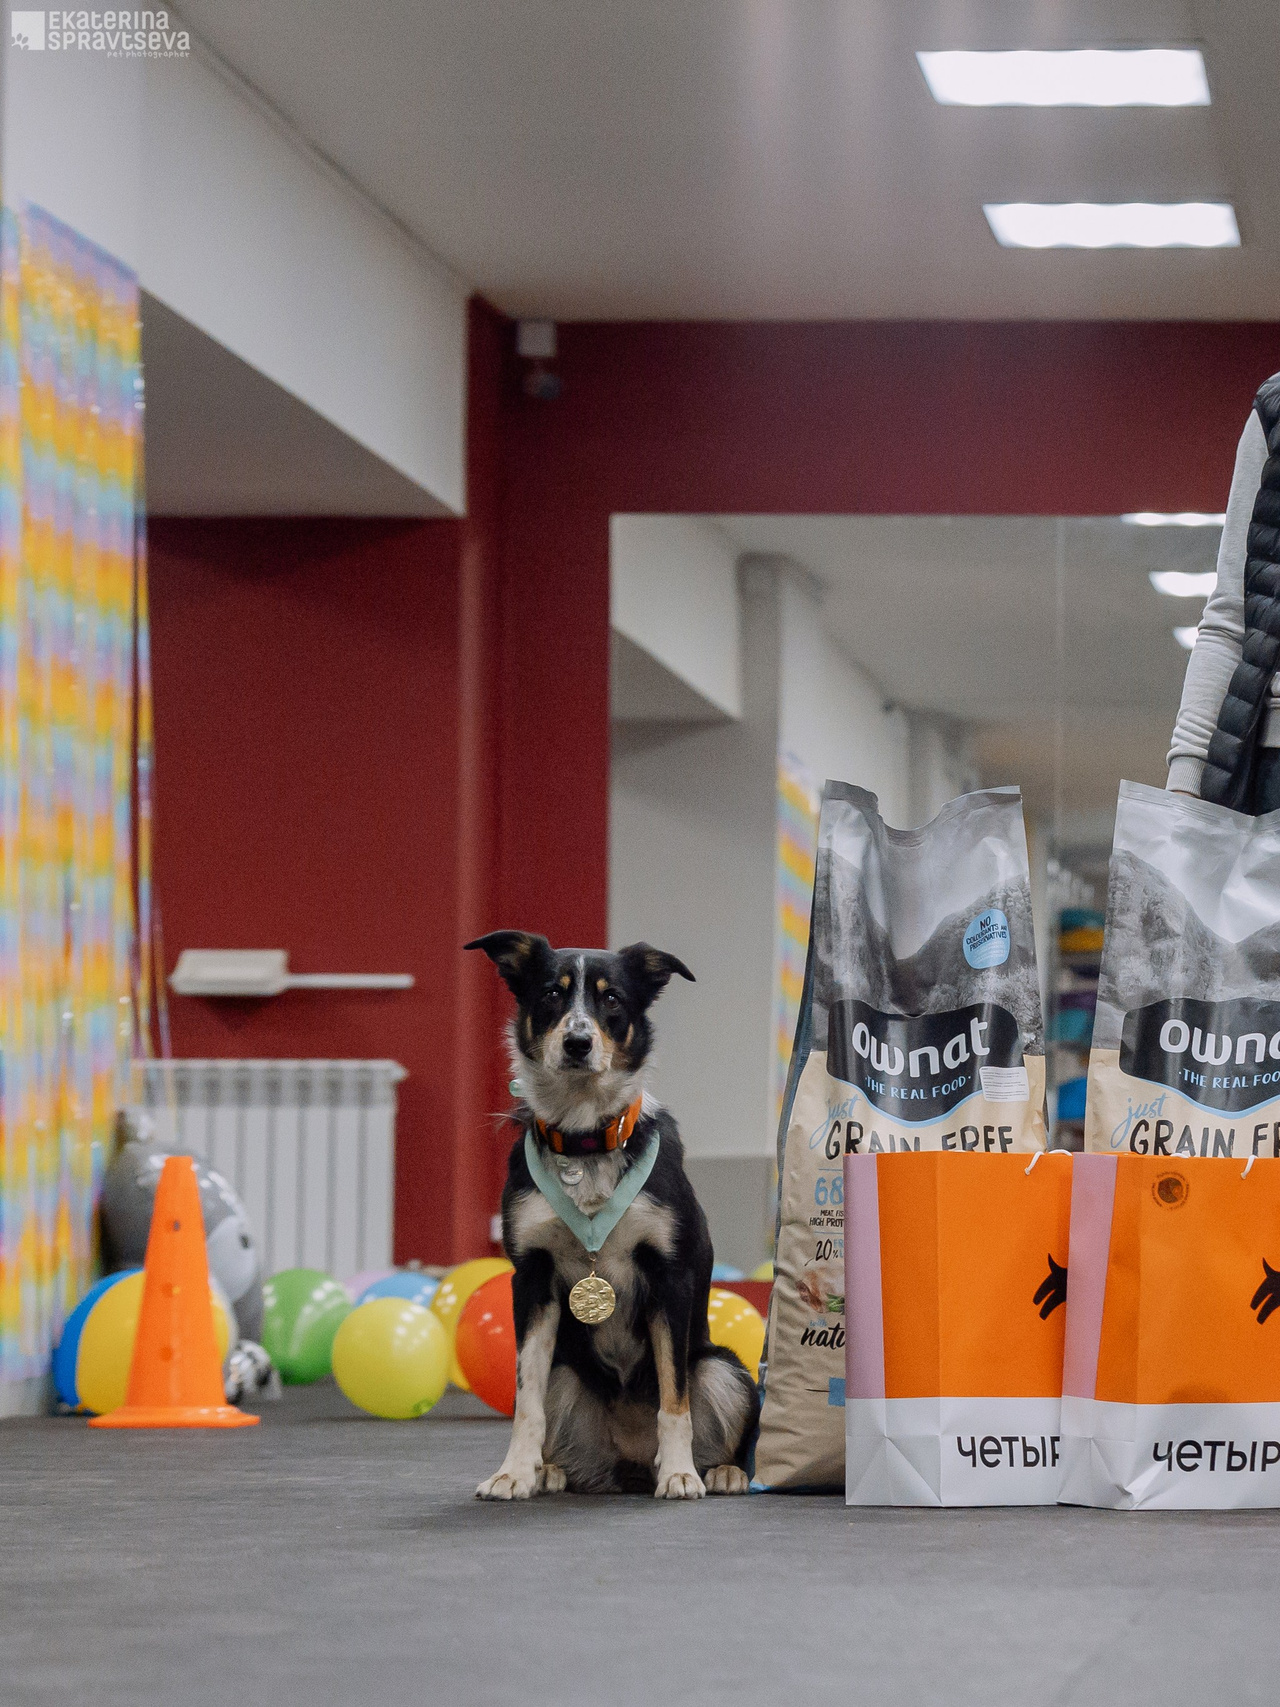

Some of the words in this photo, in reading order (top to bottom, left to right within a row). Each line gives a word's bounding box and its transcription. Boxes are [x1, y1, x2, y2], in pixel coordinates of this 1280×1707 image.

[980, 916, 991, 930] NO
[852, 1017, 990, 1077] ownat
[866, 1075, 886, 1096] THE
[890, 1088, 928, 1100] REAL
[932, 1076, 966, 1098] FOOD
[1183, 1068, 1207, 1088] THE
[1212, 1076, 1249, 1089] REAL
[809, 1094, 861, 1150] just
[1110, 1092, 1172, 1149] just
[1130, 1119, 1236, 1158] GRAIN
[809, 1217, 824, 1226] HIGH
